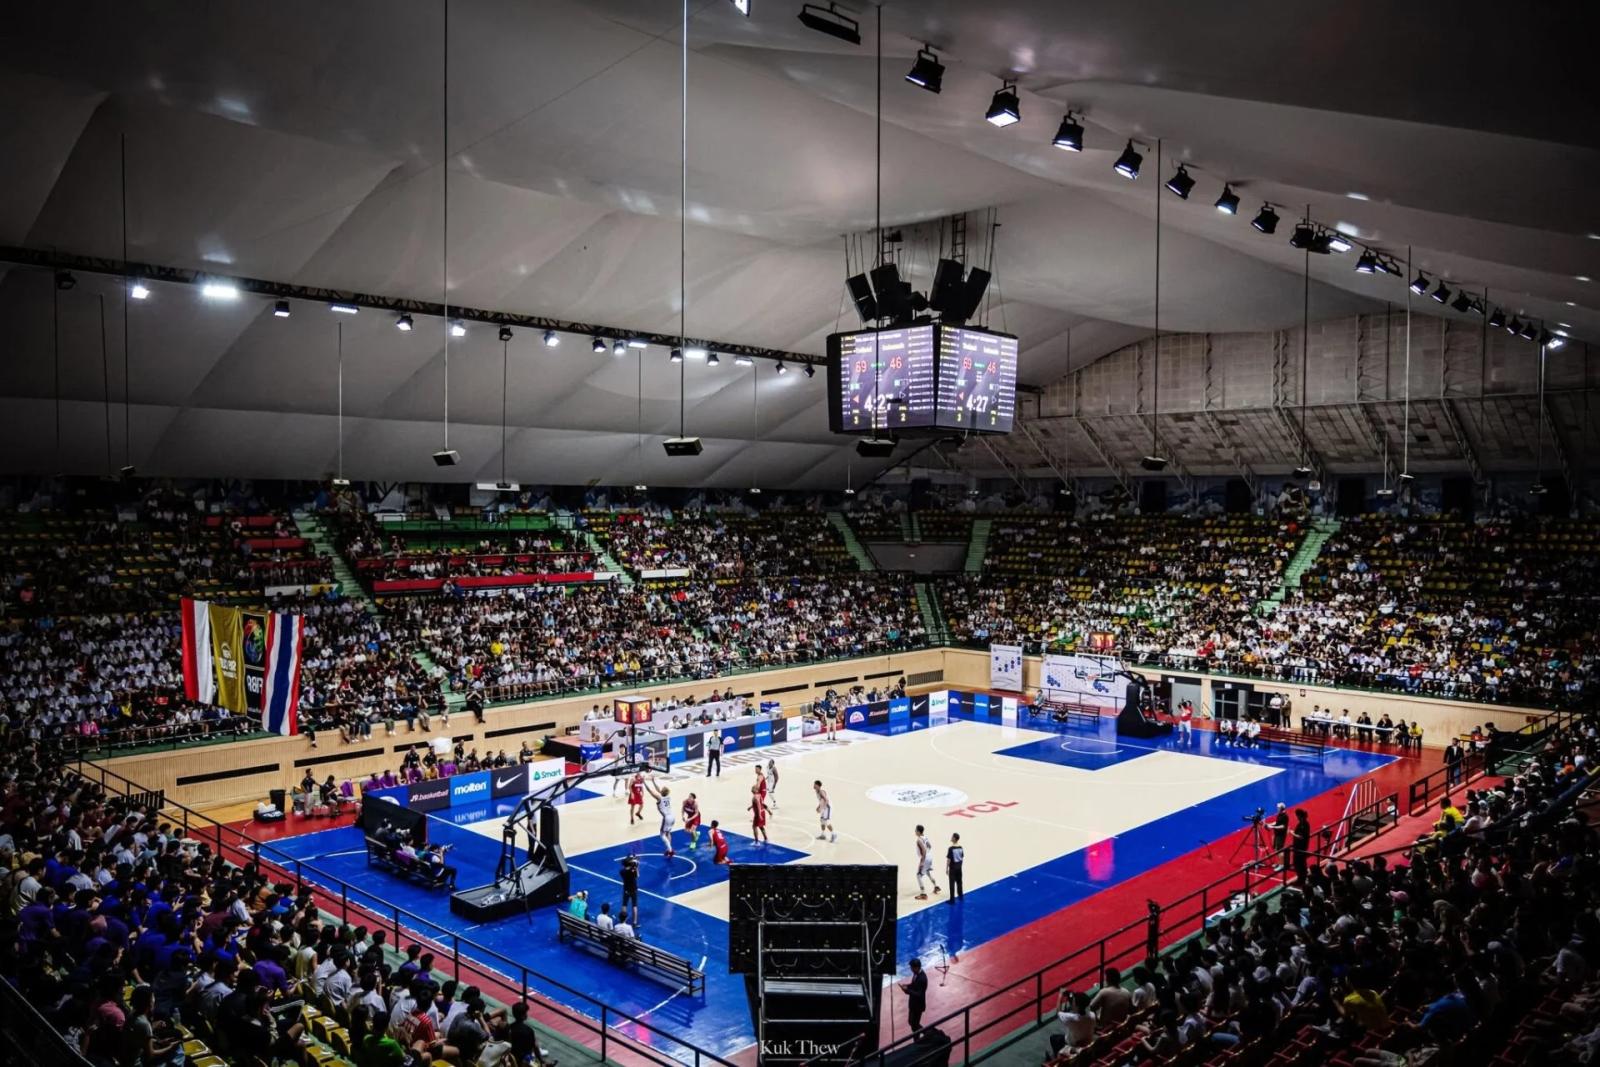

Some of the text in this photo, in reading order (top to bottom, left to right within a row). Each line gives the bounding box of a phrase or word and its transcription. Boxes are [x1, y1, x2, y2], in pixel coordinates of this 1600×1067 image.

[855, 360, 867, 373] 69
[889, 356, 902, 369] 46
[966, 394, 989, 413] 4:27
[541, 768, 562, 779] Smart
[454, 782, 487, 796] molten
[943, 801, 1019, 818] TCL
